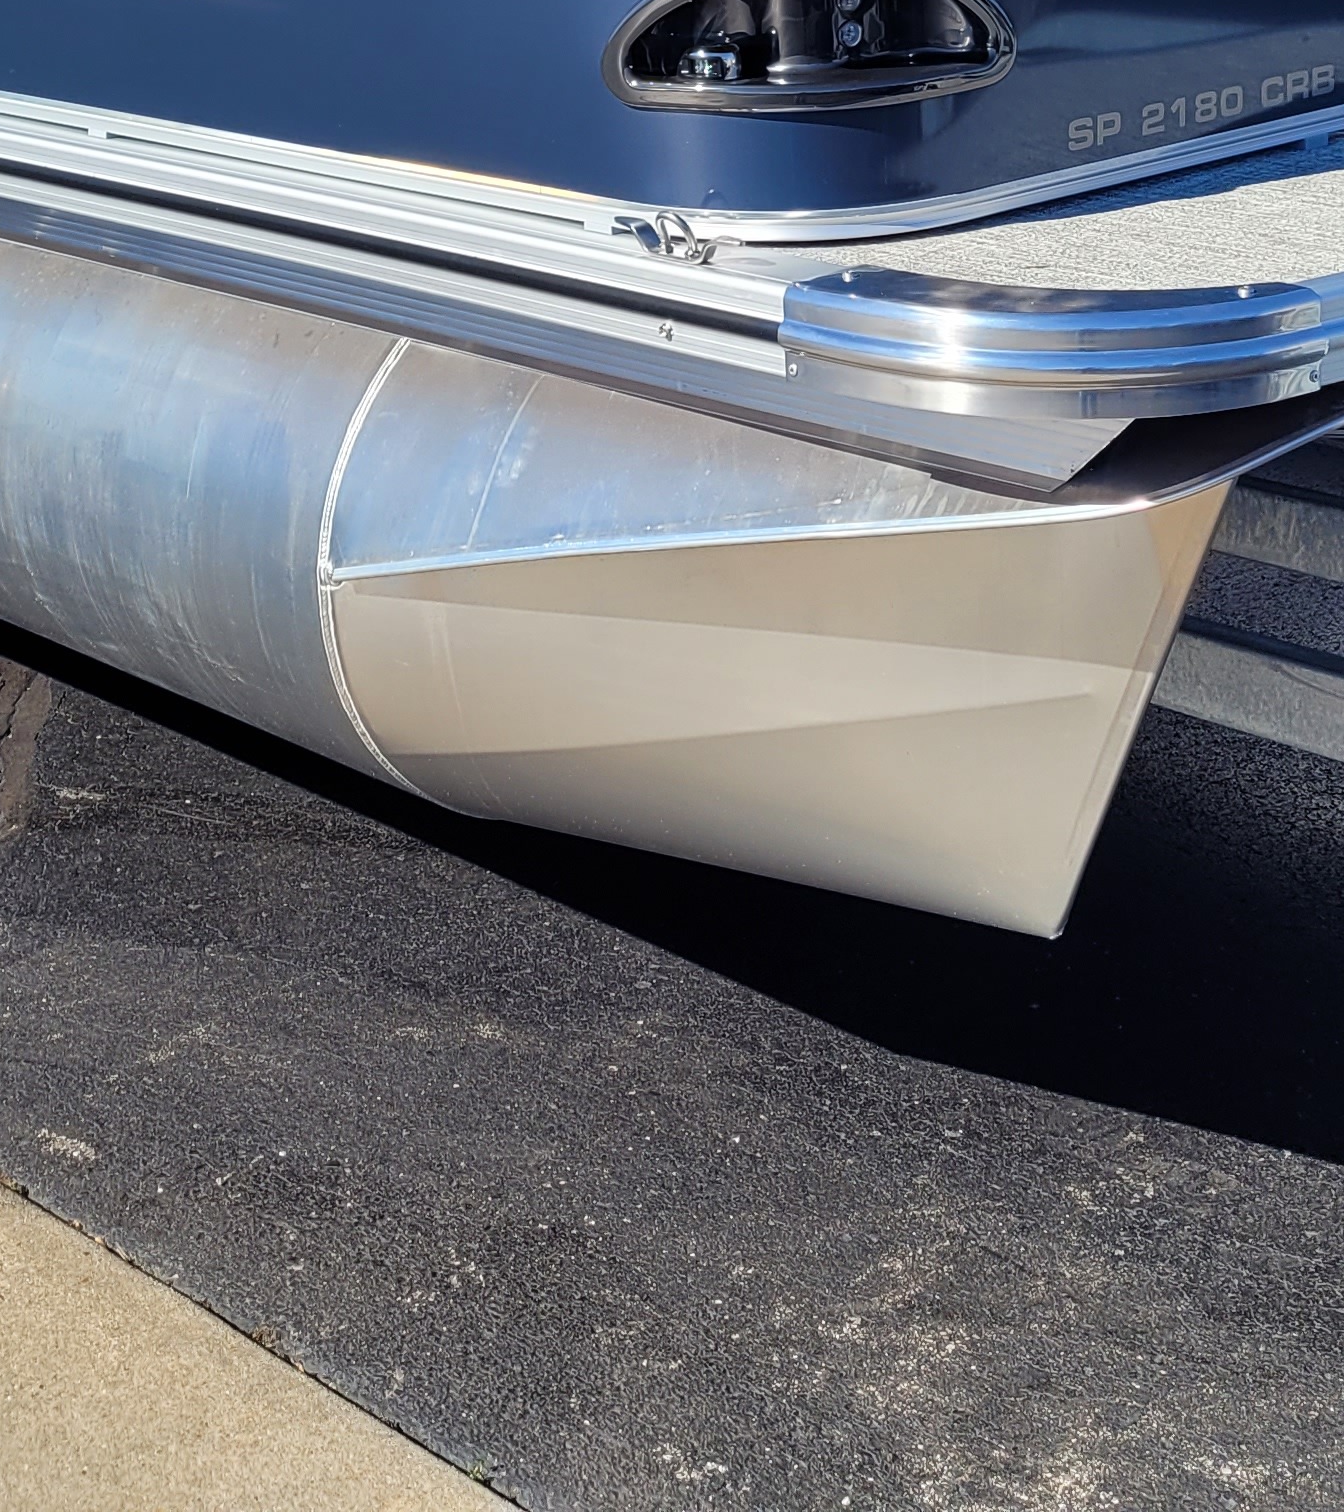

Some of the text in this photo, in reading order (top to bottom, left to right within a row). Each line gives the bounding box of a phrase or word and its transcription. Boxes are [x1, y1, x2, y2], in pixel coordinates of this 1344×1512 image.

[1068, 63, 1336, 152] SP 2180 CRB
